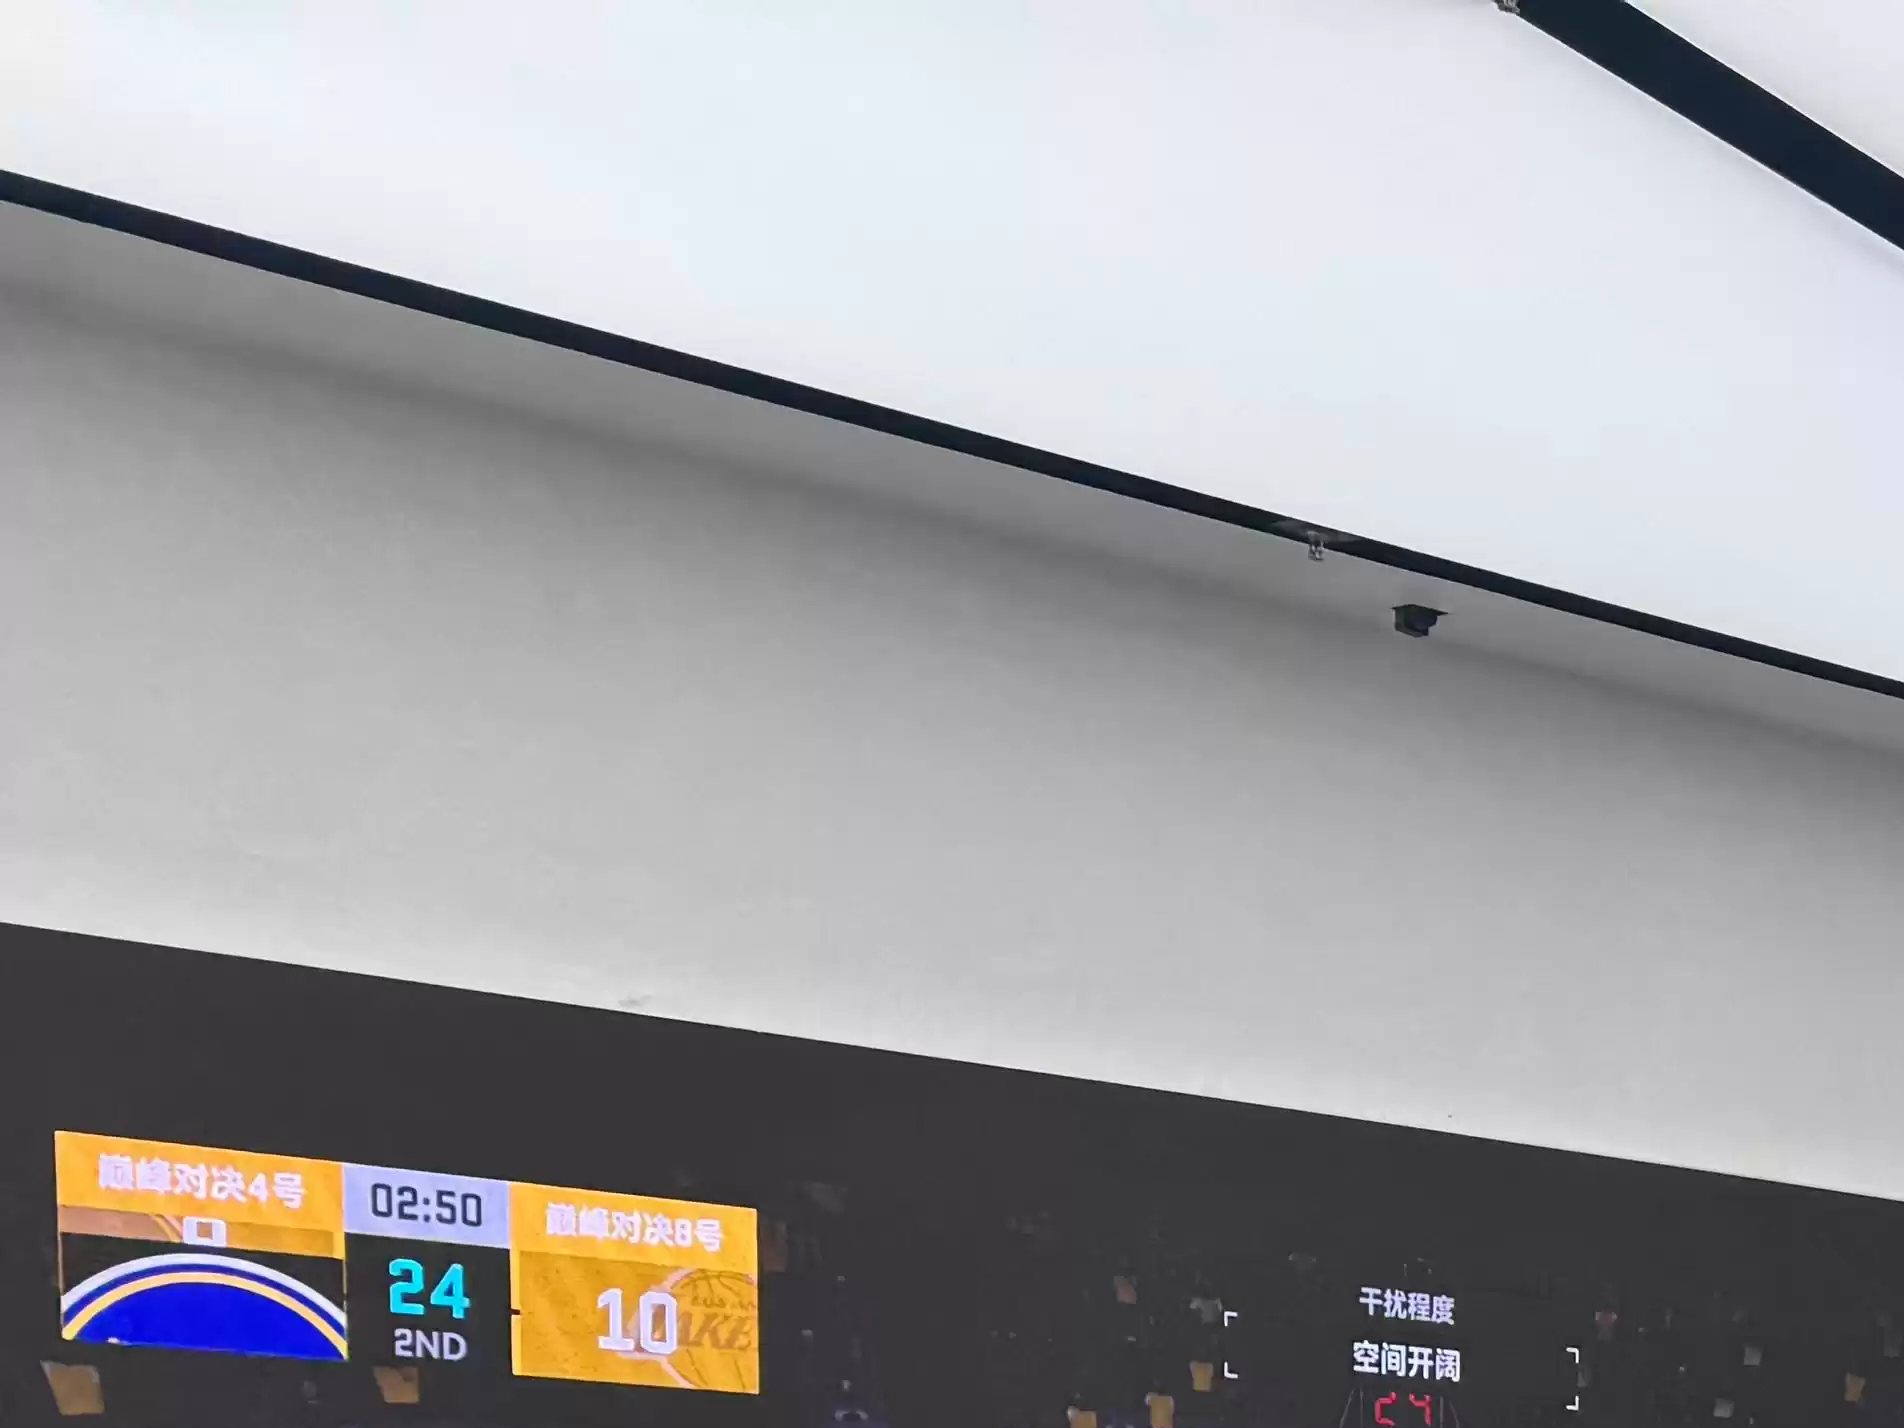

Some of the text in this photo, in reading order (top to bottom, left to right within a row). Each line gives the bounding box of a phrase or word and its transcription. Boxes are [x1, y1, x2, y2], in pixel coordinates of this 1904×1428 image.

[98, 1152, 306, 1210] 巅峰对决4号
[371, 1182, 483, 1228] 02:50
[545, 1203, 724, 1252] 巅峰对决8号
[388, 1257, 472, 1320] 24
[1358, 1286, 1456, 1326] 干扰程度
[394, 1328, 468, 1361] 2ND
[596, 1287, 679, 1355] 10
[1352, 1340, 1462, 1383] 空间开阔
